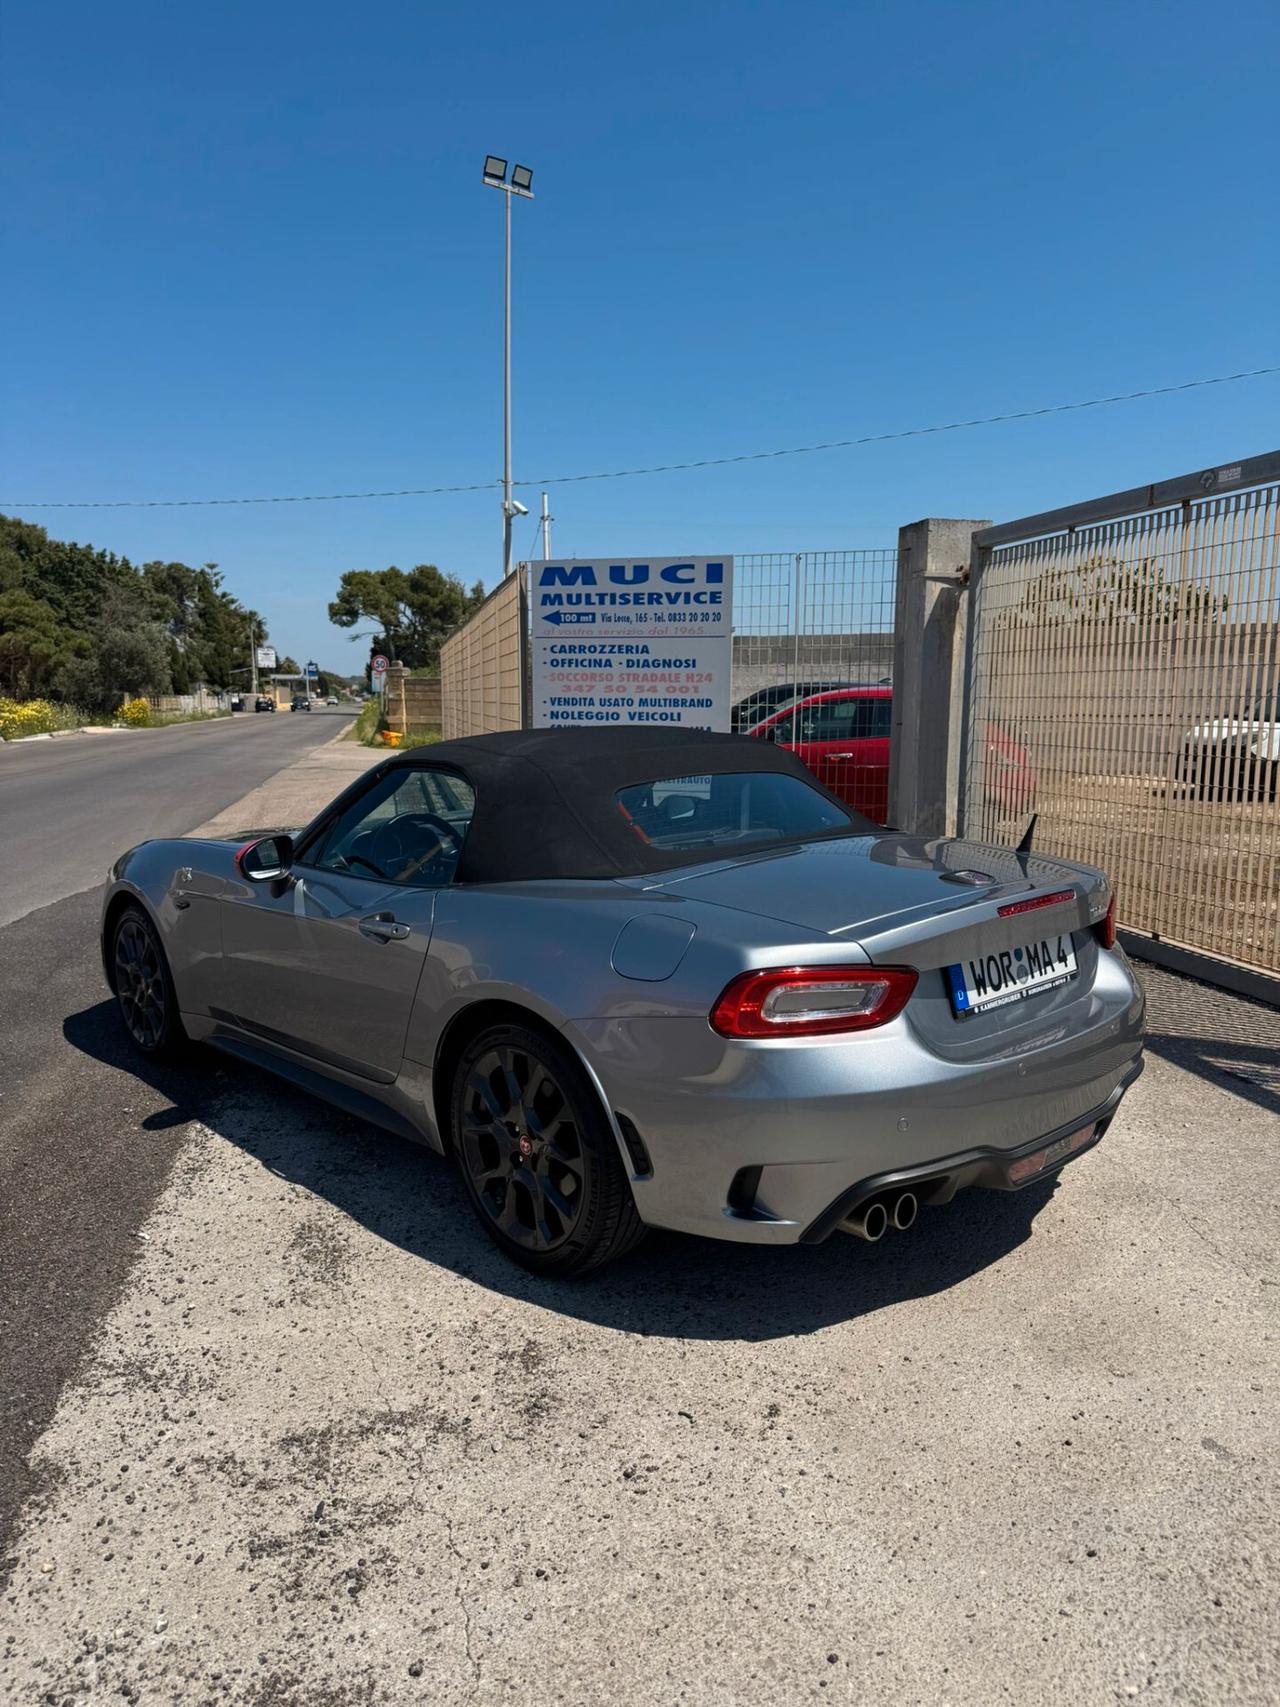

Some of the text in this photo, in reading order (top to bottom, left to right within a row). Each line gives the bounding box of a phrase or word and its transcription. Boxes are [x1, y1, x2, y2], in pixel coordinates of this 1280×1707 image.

[539, 563, 723, 586] MUCI
[540, 591, 723, 606] MULTISERVICE
[560, 613, 593, 622] 100 mt
[601, 613, 612, 623] Via
[613, 613, 633, 624] Lecce,
[635, 612, 648, 623] 165
[653, 612, 666, 623] Tel.
[668, 612, 687, 623] 0833
[689, 612, 698, 622] 20
[700, 612, 710, 622] 20
[712, 612, 722, 622] 20
[559, 626, 594, 636] vostro
[600, 626, 644, 636] servizio
[648, 626, 669, 635] dal
[550, 644, 650, 654] CARROZZERIA
[376, 660, 385, 669] 50
[550, 658, 613, 668] OFFICINA
[626, 658, 696, 669] DIAGNOSI
[550, 672, 713, 683] SOCCORSO STRADALE H24
[561, 685, 700, 694] 347 50 54 001
[550, 697, 713, 708] VENDITA USATO MULTIBRAND
[550, 711, 681, 722] NOLEGGIO VEICOLI
[969, 951, 1017, 997] WOR
[1025, 940, 1056, 980] MA
[1057, 935, 1068, 968] 4
[957, 991, 964, 1001] D
